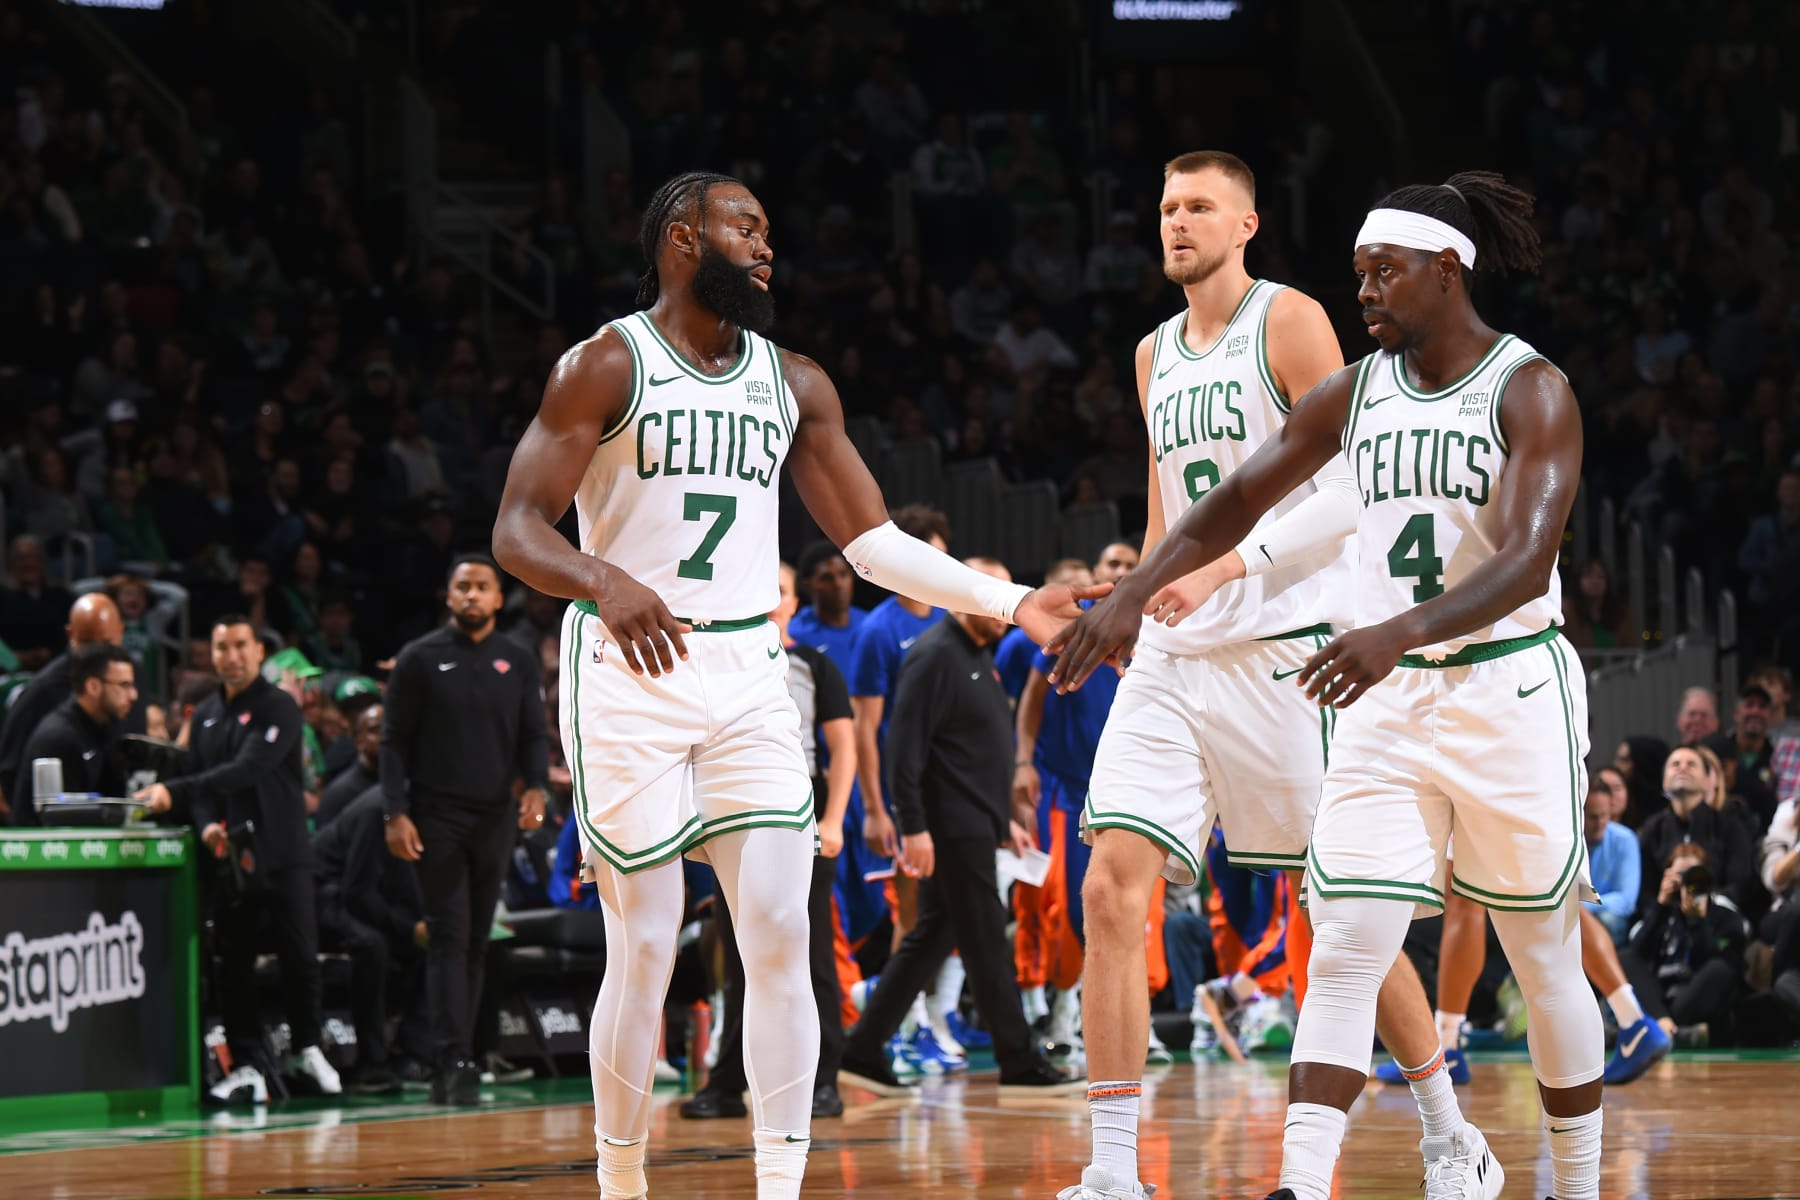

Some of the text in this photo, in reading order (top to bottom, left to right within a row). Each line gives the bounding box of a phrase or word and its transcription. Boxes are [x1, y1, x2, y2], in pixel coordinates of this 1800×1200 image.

[1227, 335, 1250, 350] VISTA
[1226, 347, 1248, 360] PRINT
[745, 380, 773, 395] VISTA
[746, 394, 773, 406] PRINT
[1461, 392, 1489, 406] VISTA
[1458, 406, 1488, 417] PRINT
[1153, 380, 1247, 464] CELTICS
[636, 409, 781, 489] CELTICS
[1356, 428, 1490, 510] CELTICS
[677, 492, 737, 581] 7
[1387, 513, 1444, 604] 4
